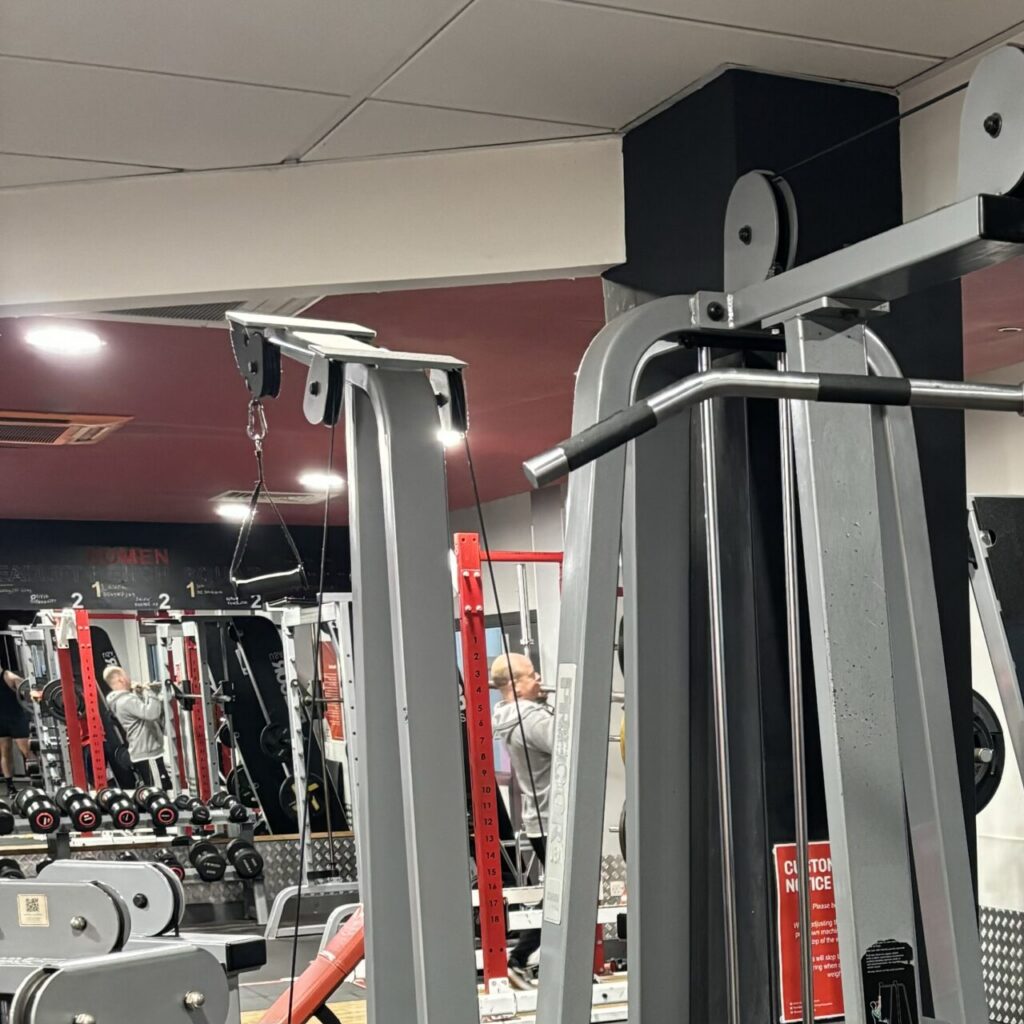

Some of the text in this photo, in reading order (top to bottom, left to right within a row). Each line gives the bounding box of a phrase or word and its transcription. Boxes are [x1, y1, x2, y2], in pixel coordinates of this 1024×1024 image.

[92, 581, 101, 598] 1
[186, 581, 195, 598] 1
[71, 592, 84, 608] 2
[159, 593, 171, 609] 2
[250, 594, 262, 609] 2
[482, 786, 491, 794] 10
[483, 802, 491, 810] 11
[484, 818, 493, 826] 12
[485, 835, 494, 843] 13
[488, 868, 496, 876] 15
[490, 899, 498, 907] 17
[491, 915, 499, 923] 18
